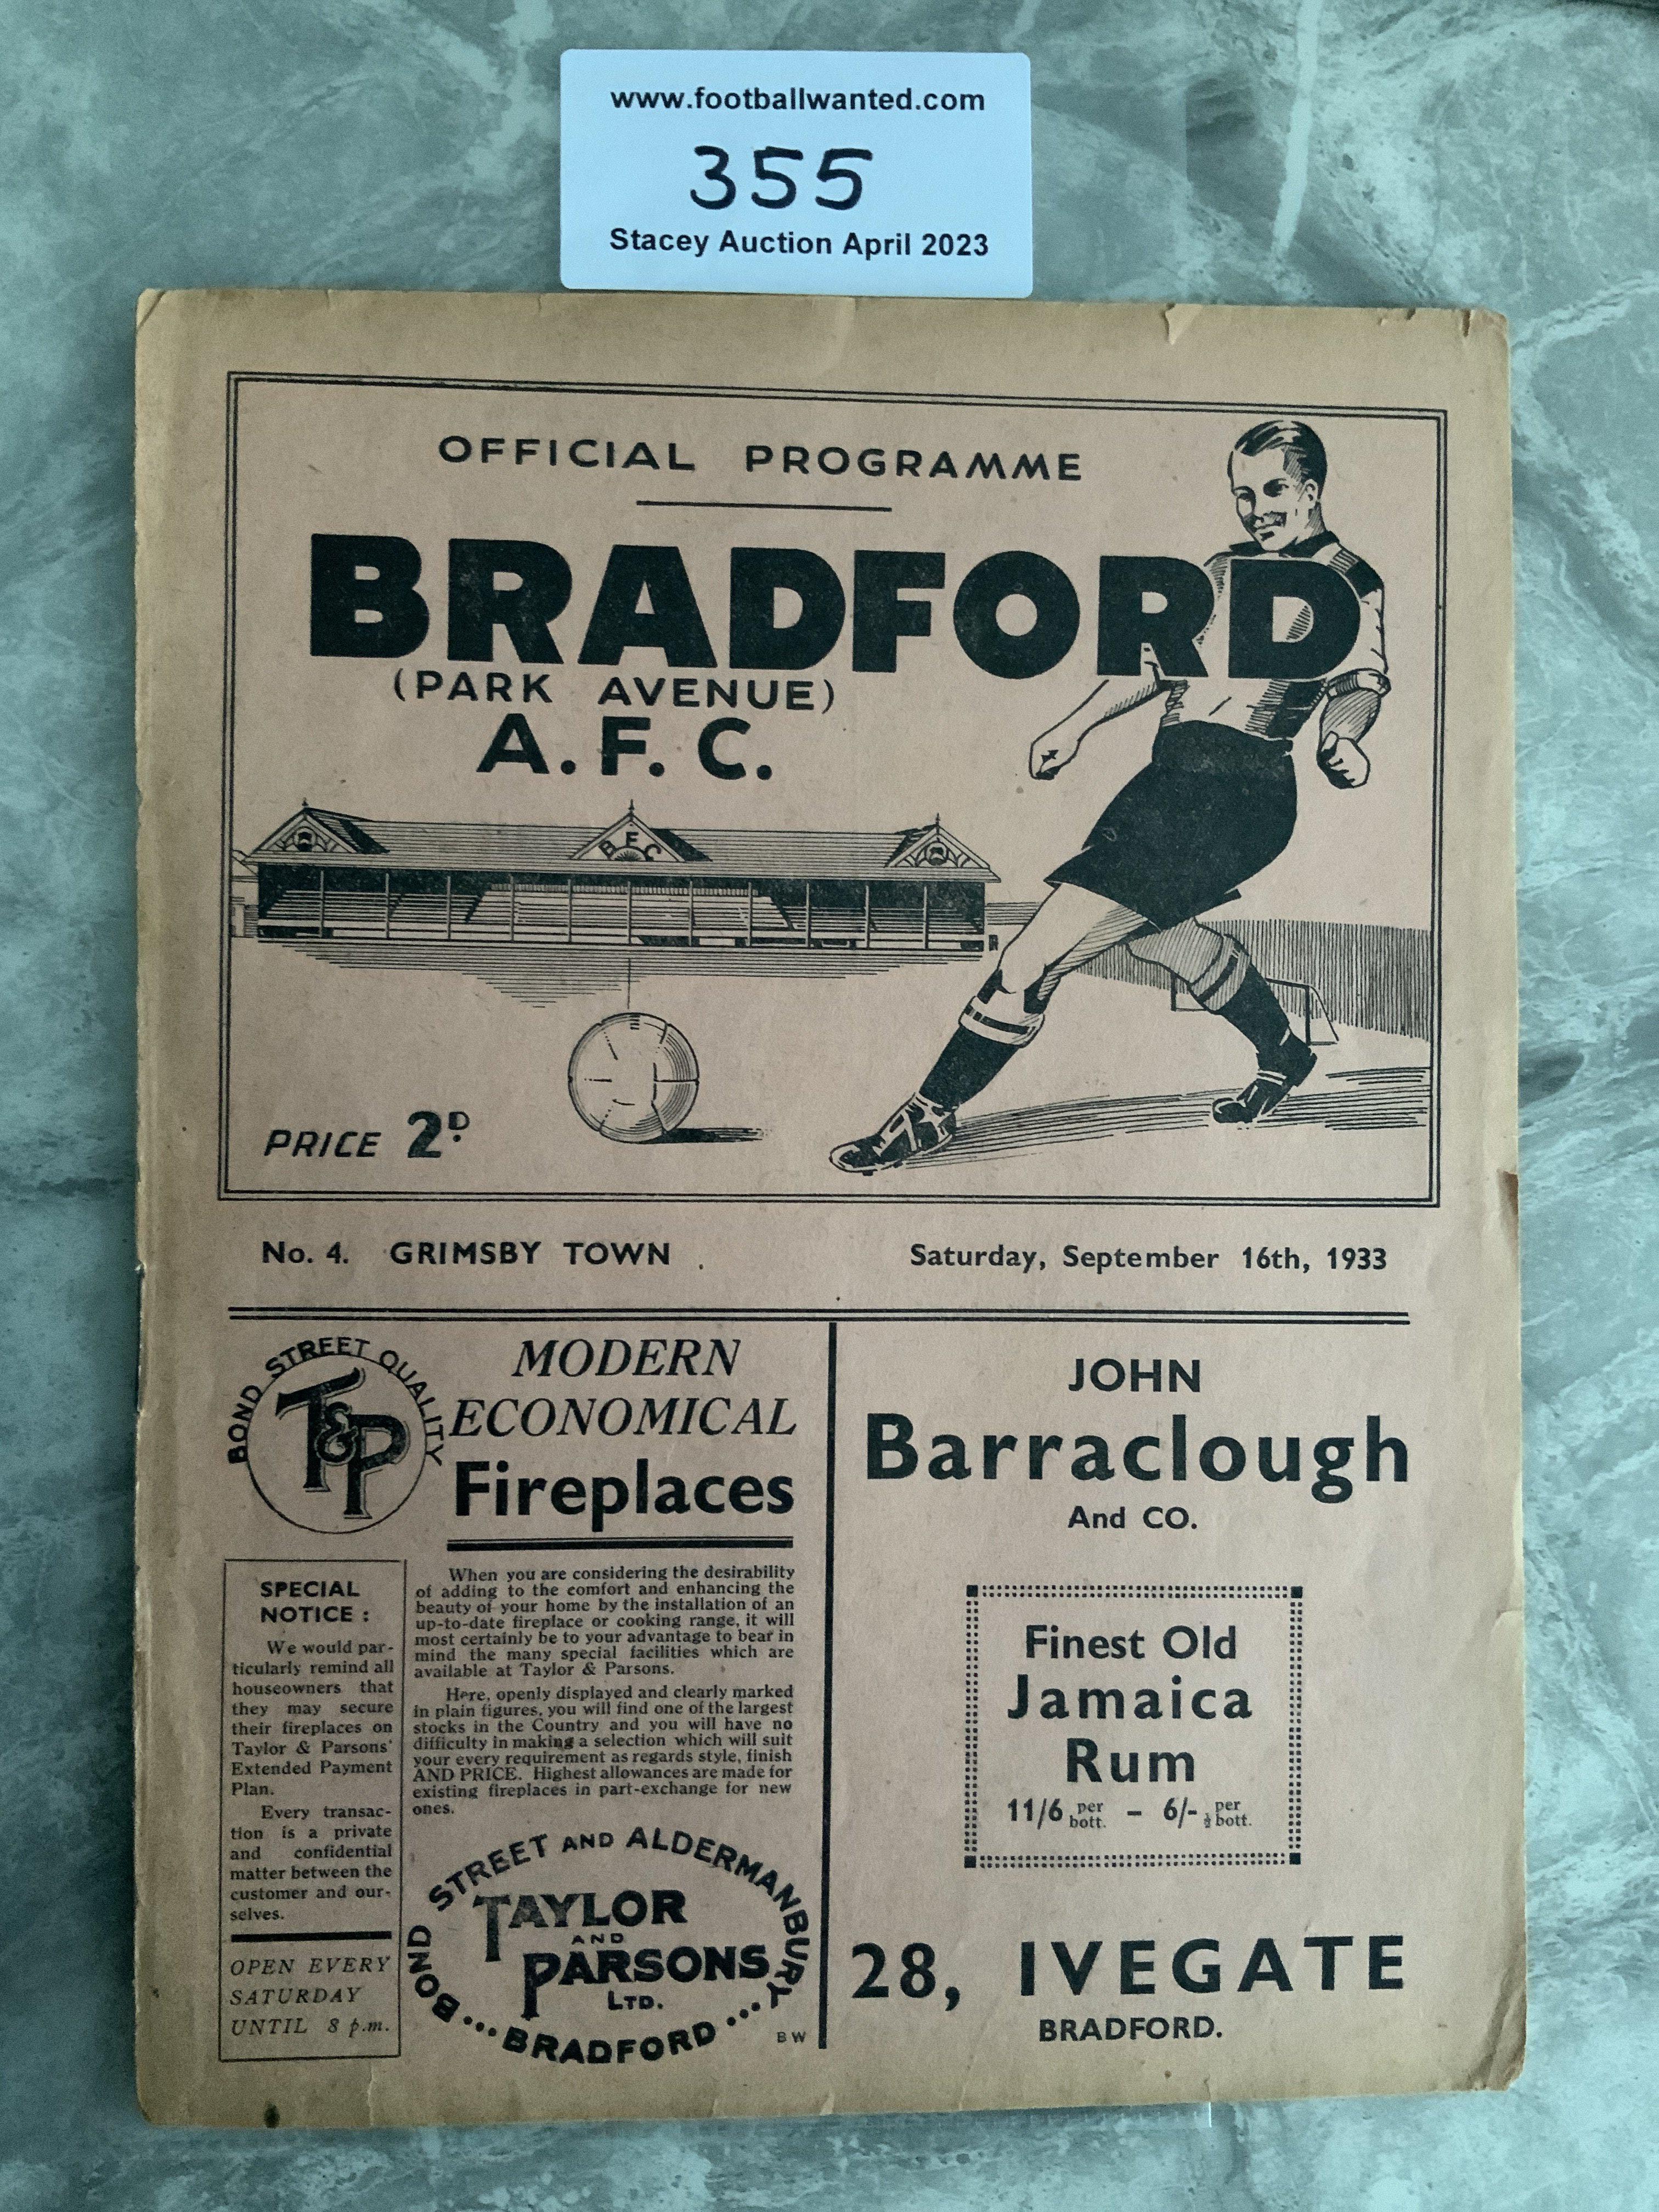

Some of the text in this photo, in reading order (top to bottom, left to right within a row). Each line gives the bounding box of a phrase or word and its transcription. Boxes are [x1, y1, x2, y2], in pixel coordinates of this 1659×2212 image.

[610, 86, 985, 111] www.footballwanted.com
[690, 145, 873, 211] 355
[610, 228, 989, 261] Stacey Auction April 2023
[438, 435, 1081, 481] OFFICIAL PROGRAMME
[309, 533, 1361, 680] BRADFORD
[393, 668, 834, 714] (PARK AVENUE)
[263, 1129, 382, 1158] PRICE
[262, 1241, 670, 1265] No. 4. GRIMSBY TOWN
[910, 1243, 1387, 1275] Saturday, September 16th, 1933
[511, 1338, 741, 1378] MODERN
[1068, 1358, 1200, 1393] JOHN
[228, 1337, 444, 1466] BOND STREET QUALITY
[448, 1397, 797, 1437] ECONOMICAL
[867, 1413, 1408, 1504] Barraclough
[455, 1458, 794, 1533] Fireplaces
[1068, 1505, 1197, 1530] And CO.
[448, 1565, 795, 1583] When you are considering the desirability
[261, 1581, 360, 1598] SPECIAL
[415, 1581, 794, 1600] of adding to the comfort and enhancing the
[415, 1616, 505, 1632] up-to-date
[512, 1615, 583, 1632] fireplace
[591, 1617, 609, 1627] or
[616, 1613, 681, 1629] cooking
[746, 1613, 758, 1626] it
[765, 1613, 794, 1626] will
[267, 1640, 297, 1655] We
[302, 1640, 352, 1655] would
[1025, 1624, 1237, 1660] Finest Old
[414, 1645, 794, 1662] mind the many special facilities which are
[232, 1659, 394, 1677] ticularly remind all
[414, 1661, 674, 1679] available at Taylor & Parsons.
[232, 1679, 393, 1696] houseowners that
[1007, 1674, 1252, 1720] Jamaica
[231, 1701, 394, 1717] they may secure
[232, 1720, 393, 1736] their fireplaces on
[232, 1741, 287, 1757] Taylor
[295, 1740, 310, 1755] &
[231, 1759, 392, 1776] Extended Payment
[1066, 1737, 1194, 1783] Rum
[412, 1765, 792, 1782] AND PRICE. Highest allowances are made for
[232, 1782, 275, 1797] Plan.
[412, 1781, 792, 1799] existing fireplaces in part-exchange for new
[261, 1805, 392, 1820] Every transac-
[411, 1803, 455, 1817] ones.
[1007, 1797, 1063, 1830] 11/6
[1077, 1802, 1103, 1815] per
[1215, 1801, 1242, 1813] per
[1069, 1815, 1107, 1829] bott.
[1215, 1813, 1252, 1826] bott.
[230, 1824, 392, 1841] tion is a private
[229, 1843, 392, 1861] and confidential
[230, 1864, 392, 1881] matter between the
[230, 1887, 308, 1901] customer
[315, 1884, 347, 1899] and
[229, 1907, 285, 1922] selves.
[407, 1826, 811, 2023] BOND STREET AND ALDERMANBURY
[472, 1889, 688, 1962] TAYLOR
[571, 1932, 624, 1945] AND
[230, 1956, 391, 1976] OPEN EVERY
[851, 1934, 1403, 2012] 28, IVEGATE
[521, 1944, 770, 2021] PARSONS
[229, 1987, 362, 2006] SATURDAY
[231, 2017, 308, 2036] UNTIL
[327, 2018, 340, 2033] 8
[1039, 2016, 1222, 2042] BRADFORD.
[502, 2020, 716, 2064] BRADFORD
